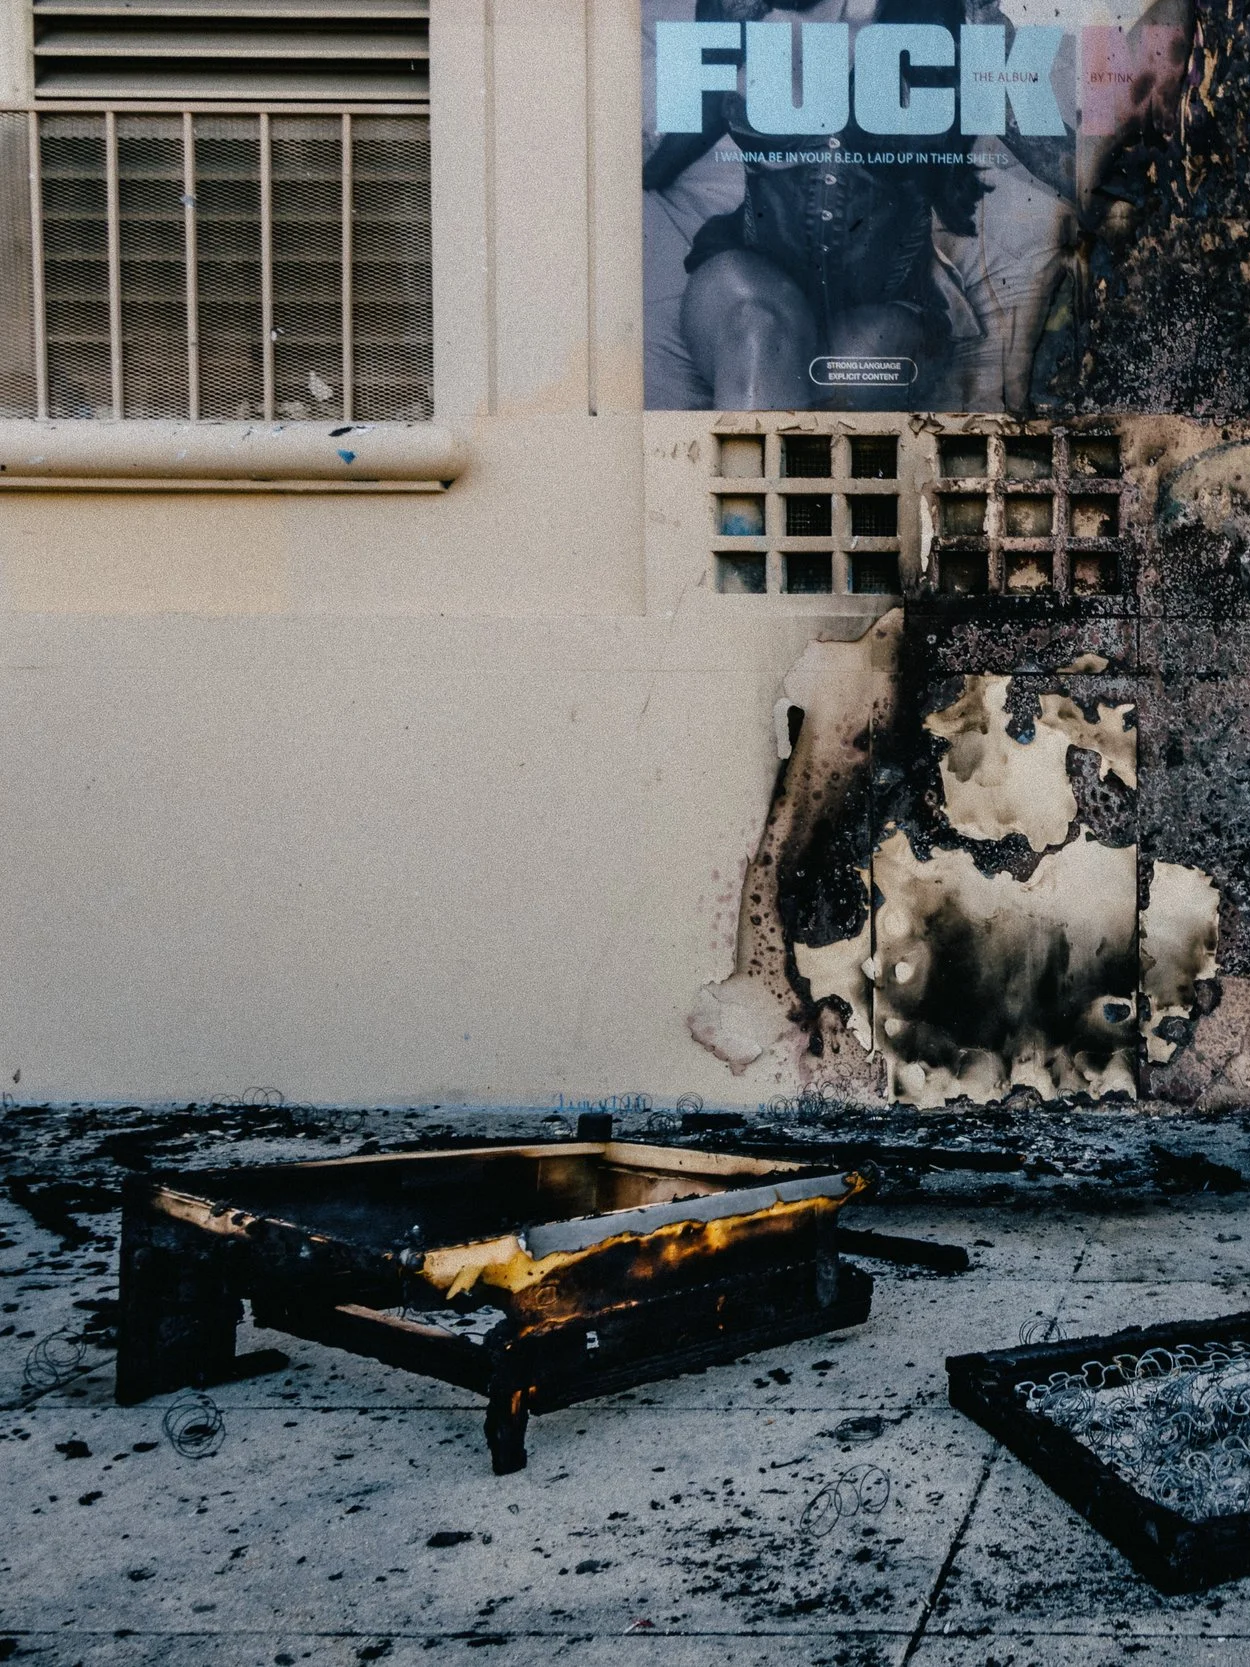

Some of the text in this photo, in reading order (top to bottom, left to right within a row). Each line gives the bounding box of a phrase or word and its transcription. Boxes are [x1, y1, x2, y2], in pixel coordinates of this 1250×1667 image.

[656, 21, 1068, 137] FUCK
[973, 72, 1039, 83] THE ALBUM
[1090, 72, 1133, 83] BY TINK
[720, 151, 765, 163] WANNA
[769, 152, 783, 163] BE
[786, 152, 798, 163] IN
[799, 152, 832, 163] YOUR
[868, 152, 895, 163] LAID
[897, 152, 913, 164] UP
[916, 152, 928, 164] IN
[930, 153, 964, 164] THEM
[966, 153, 1009, 165] SHEETS
[826, 361, 901, 370] STRONG LANGUAGE
[828, 373, 899, 381] EXPLICIT CONTENT
